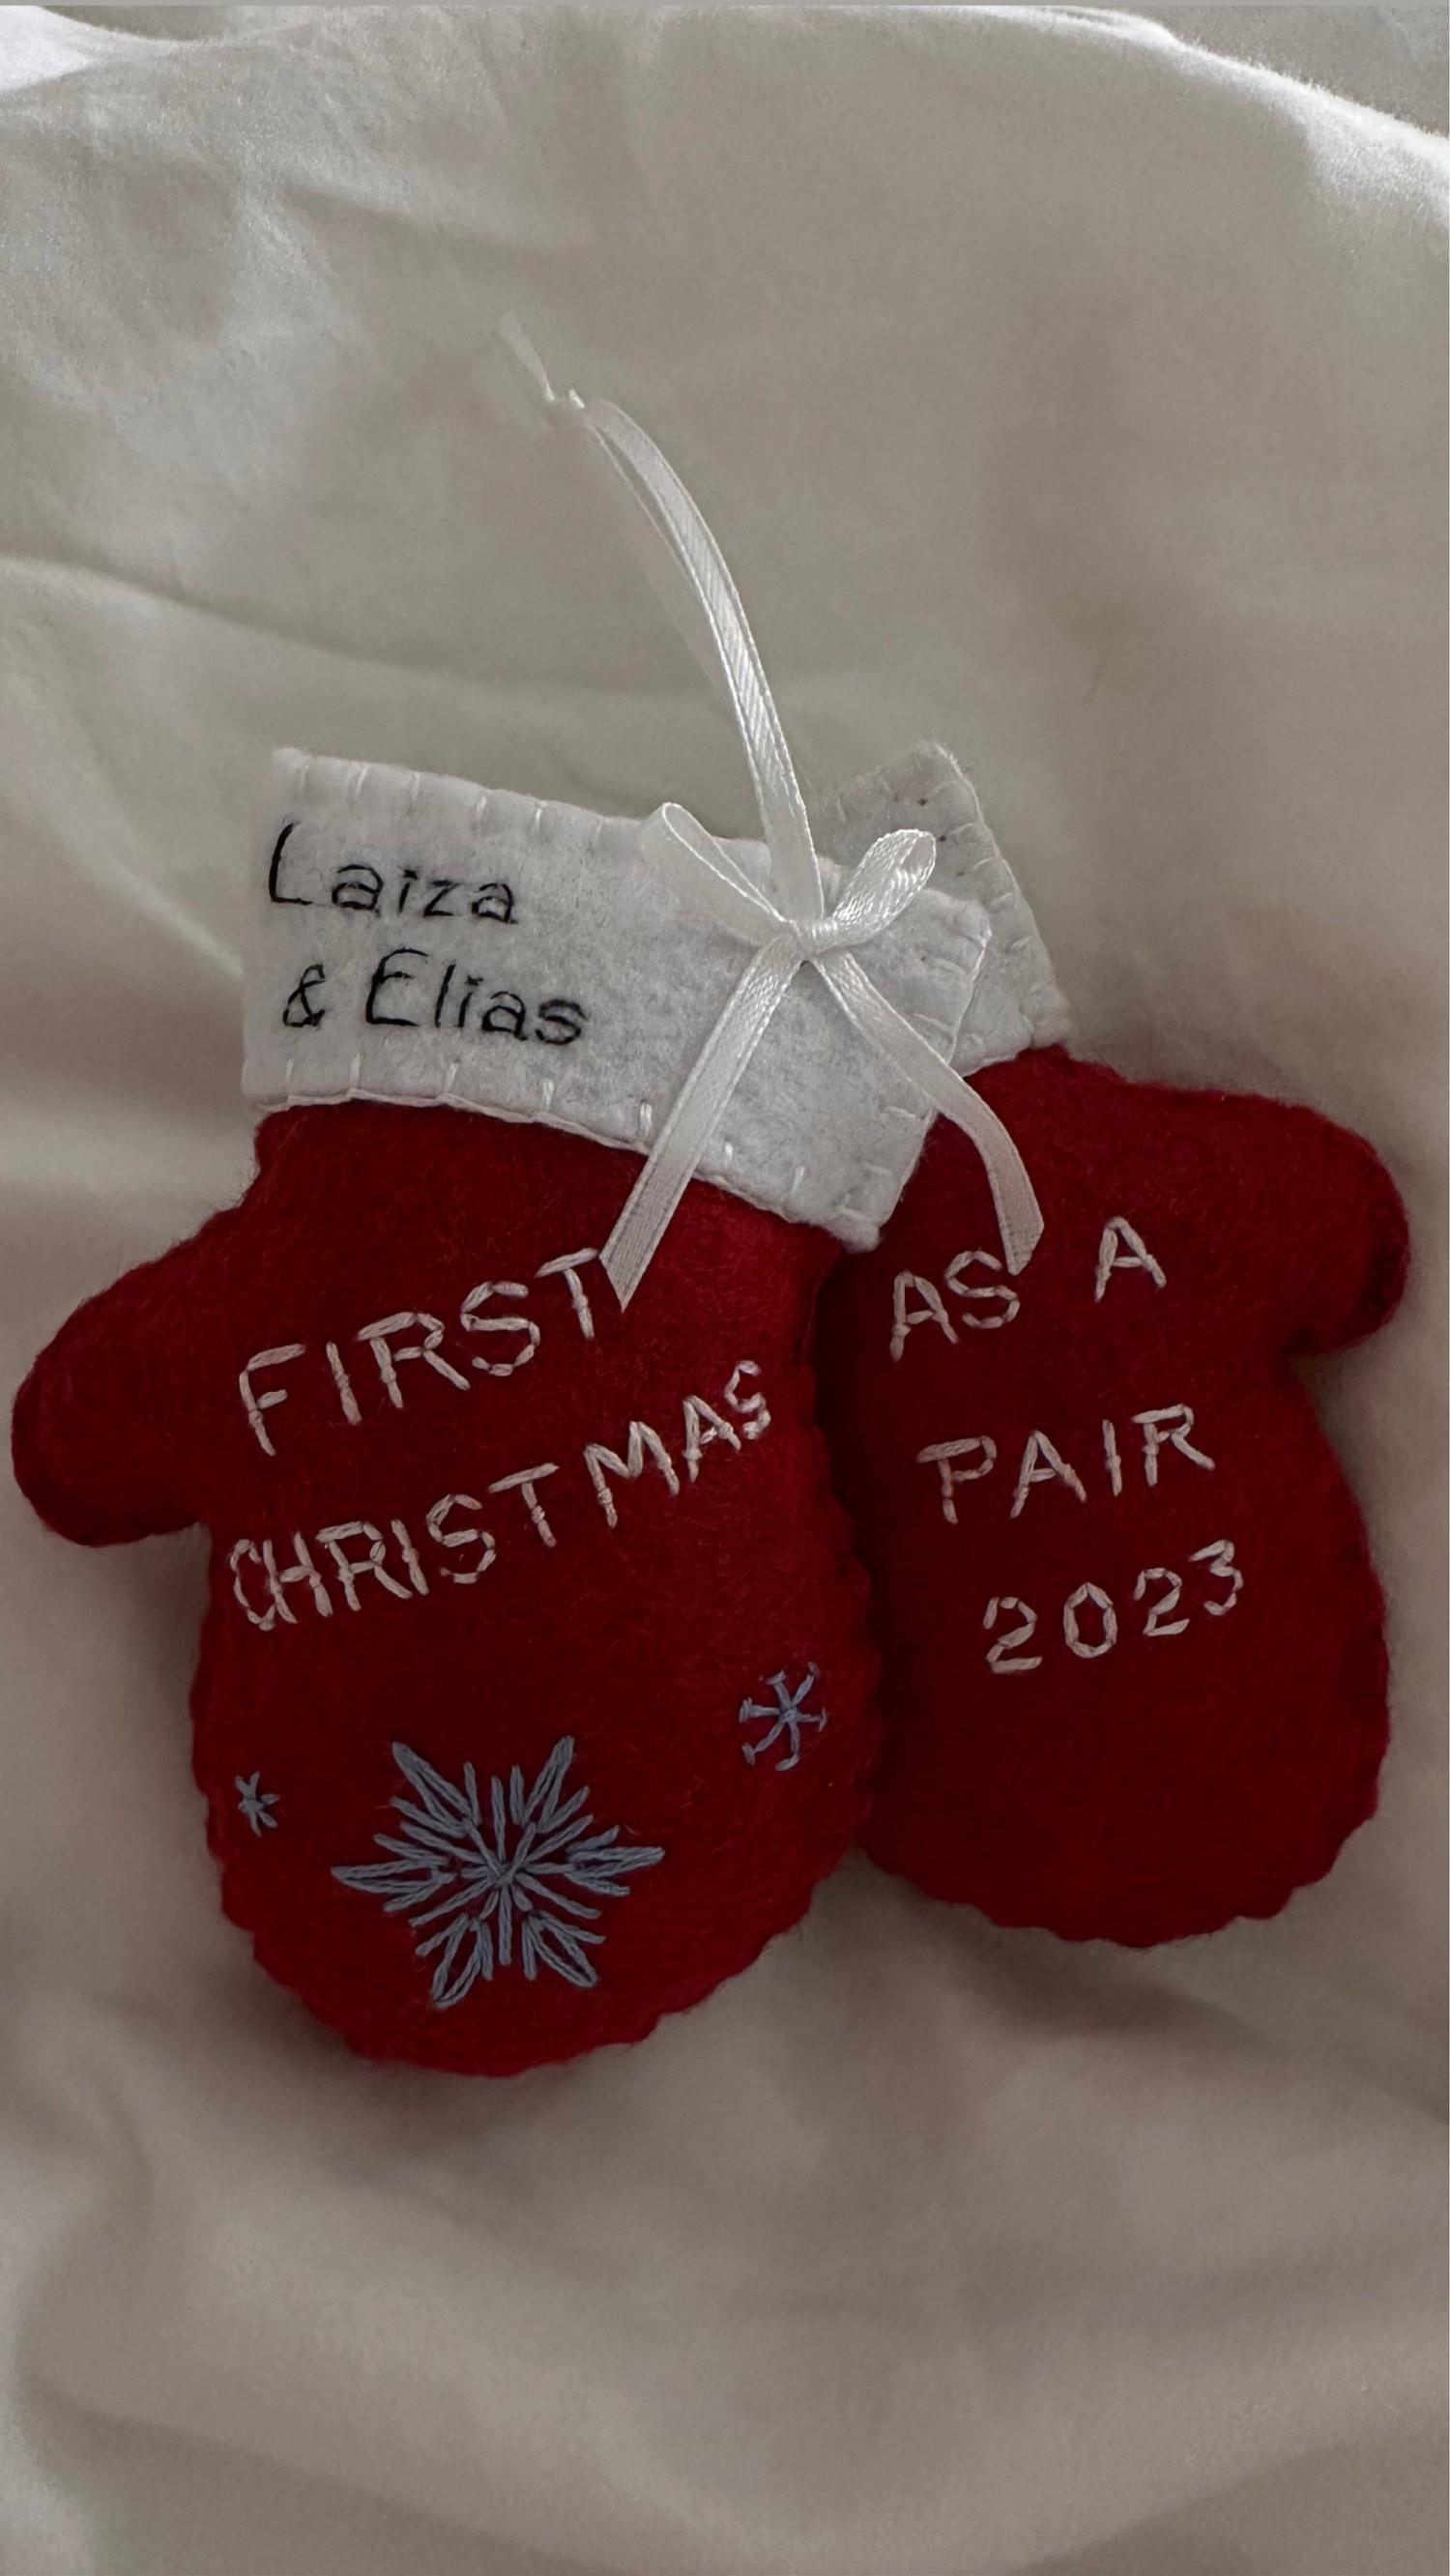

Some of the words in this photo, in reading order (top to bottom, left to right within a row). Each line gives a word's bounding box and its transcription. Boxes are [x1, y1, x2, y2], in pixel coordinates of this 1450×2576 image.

[267, 819, 518, 923] Laiza
[282, 965, 326, 1028] &
[365, 947, 587, 1046] Elias
[239, 1248, 599, 1456] FIRST
[890, 1250, 1020, 1361] AS
[1095, 1217, 1166, 1302] A
[230, 1360, 771, 1632] CHRISTMAS
[916, 1404, 1215, 1524] PAIR
[983, 1540, 1243, 1674] 2023
